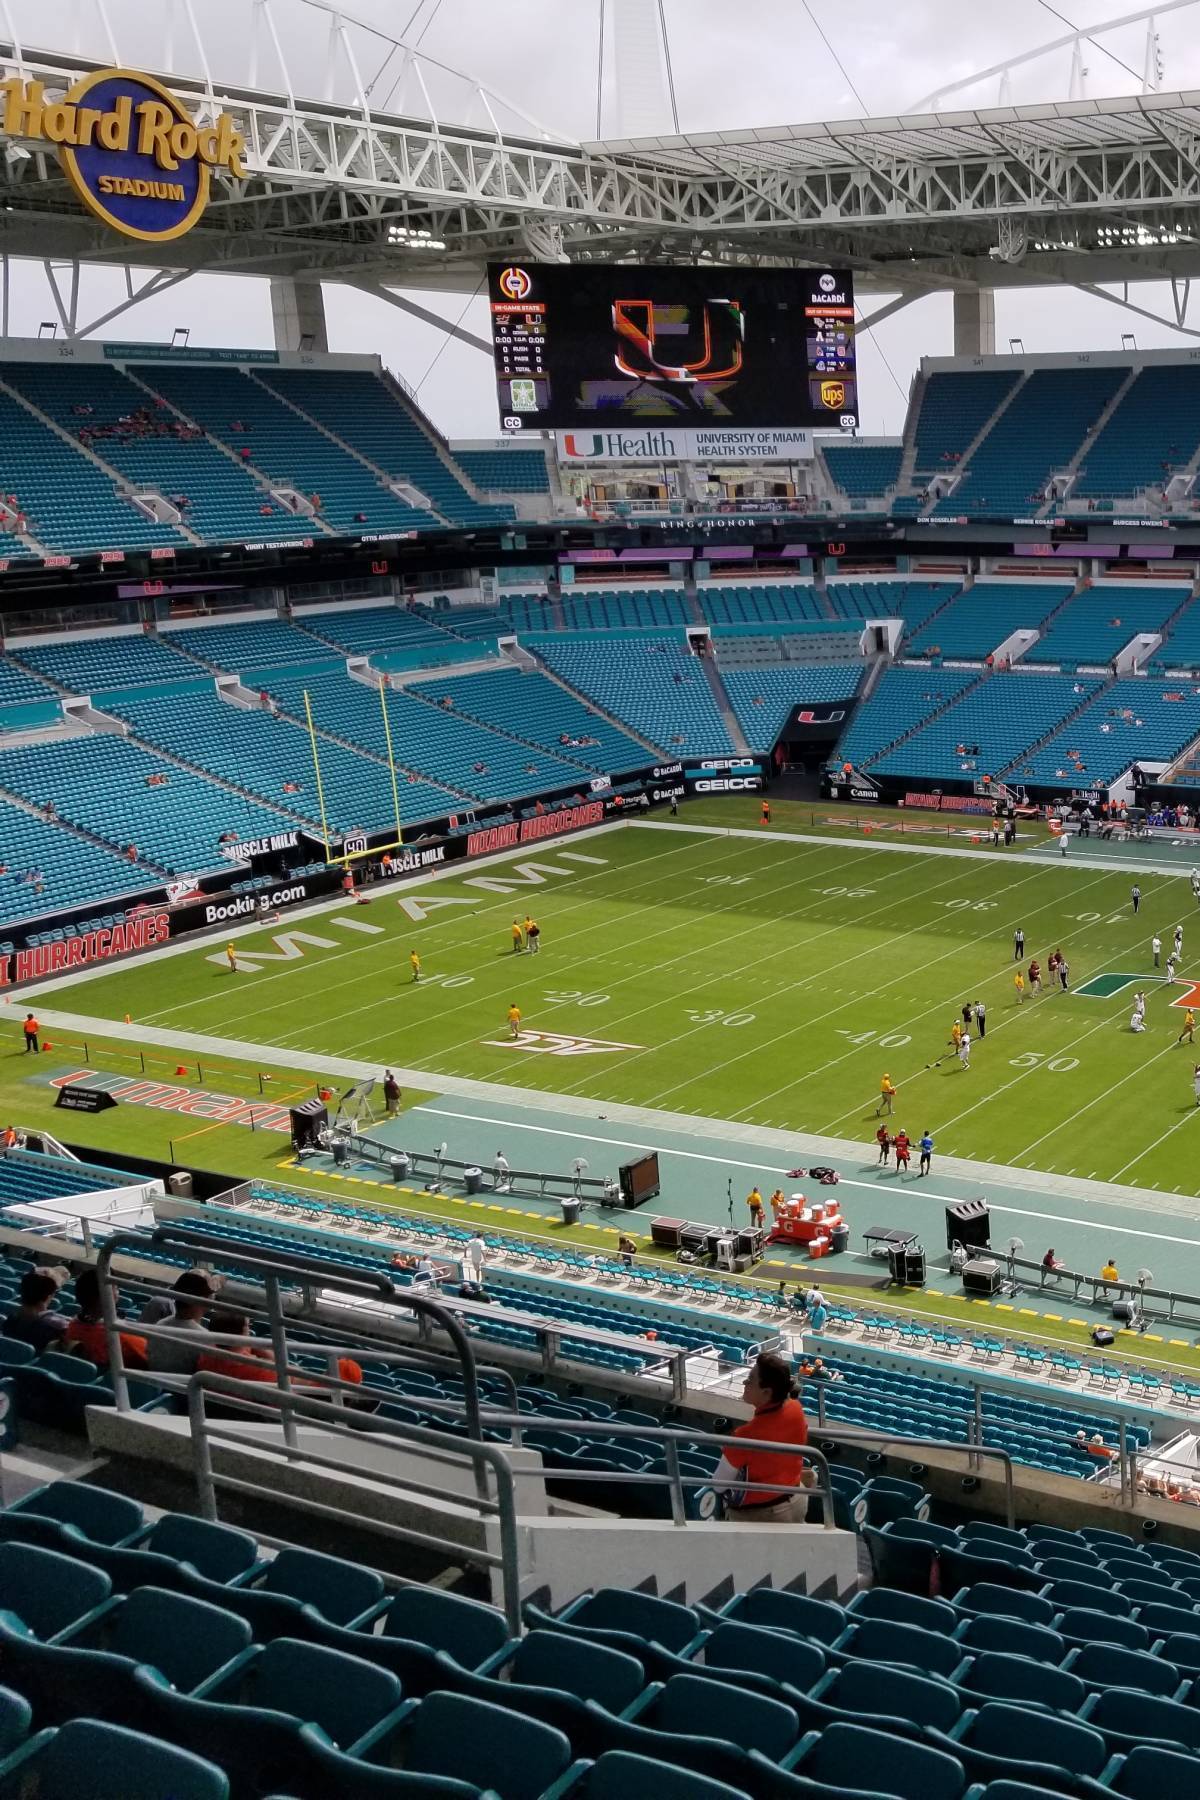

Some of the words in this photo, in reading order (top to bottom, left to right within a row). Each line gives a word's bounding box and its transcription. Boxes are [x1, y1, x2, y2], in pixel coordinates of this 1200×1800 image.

[0, 78, 132, 151] Hard
[135, 100, 248, 180] Rock
[98, 175, 186, 201] STADIUM
[812, 293, 845, 303] BACARDÍ
[822, 390, 843, 405] ups
[696, 433, 755, 443] UNIVERSITY
[757, 433, 770, 443] OF
[773, 432, 806, 443] MIAMI
[697, 445, 735, 456] HEALTH
[738, 445, 778, 455] SYSTEM
[660, 521, 695, 529] RING
[707, 520, 755, 528] HONOR
[660, 762, 682, 776] BACARDÍ
[701, 758, 754, 770] GEICO
[850, 788, 879, 799] Canon
[467, 822, 520, 857] MIAMI
[521, 801, 604, 842] HURRICANES
[223, 837, 270, 858] MUSCLE
[271, 831, 299, 851] MILK
[421, 846, 445, 866] MILK
[17, 913, 170, 984] HURRICANES
[554, 990, 611, 1007] 20
[690, 1009, 757, 1027] 30
[845, 1030, 913, 1049] 40
[1008, 1052, 1081, 1073] 50
